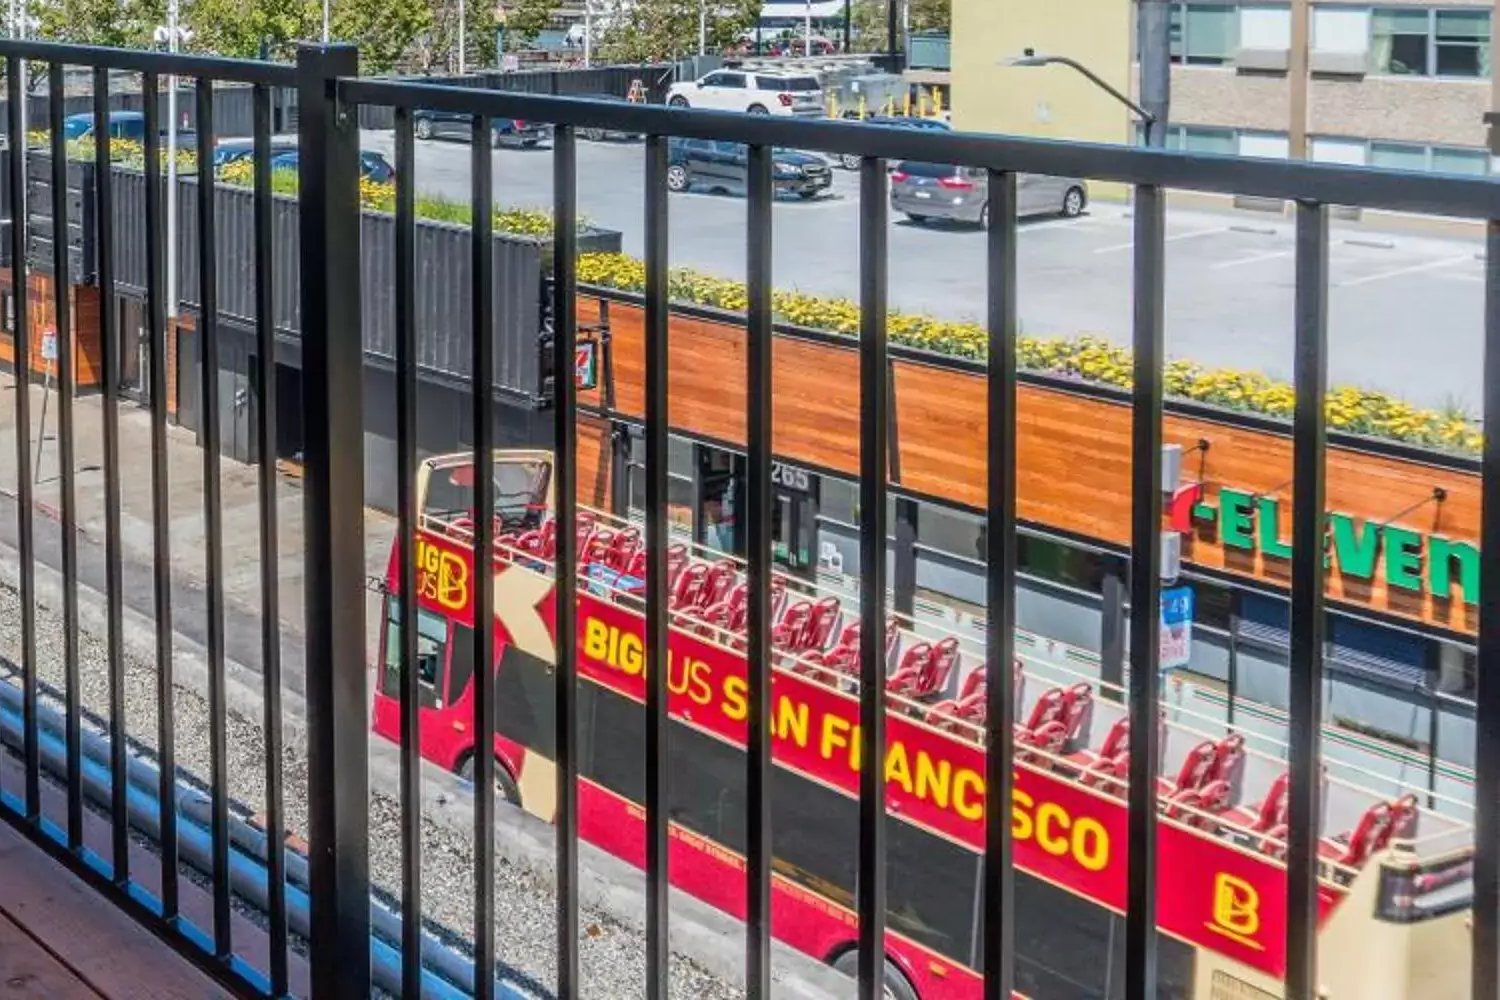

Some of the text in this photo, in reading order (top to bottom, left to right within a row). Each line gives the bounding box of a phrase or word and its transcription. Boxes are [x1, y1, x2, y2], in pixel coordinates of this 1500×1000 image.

[771, 460, 810, 490] 265
[416, 541, 440, 574] IG
[583, 615, 643, 675] BIG
[644, 648, 713, 705] US
[720, 674, 809, 748] SN
